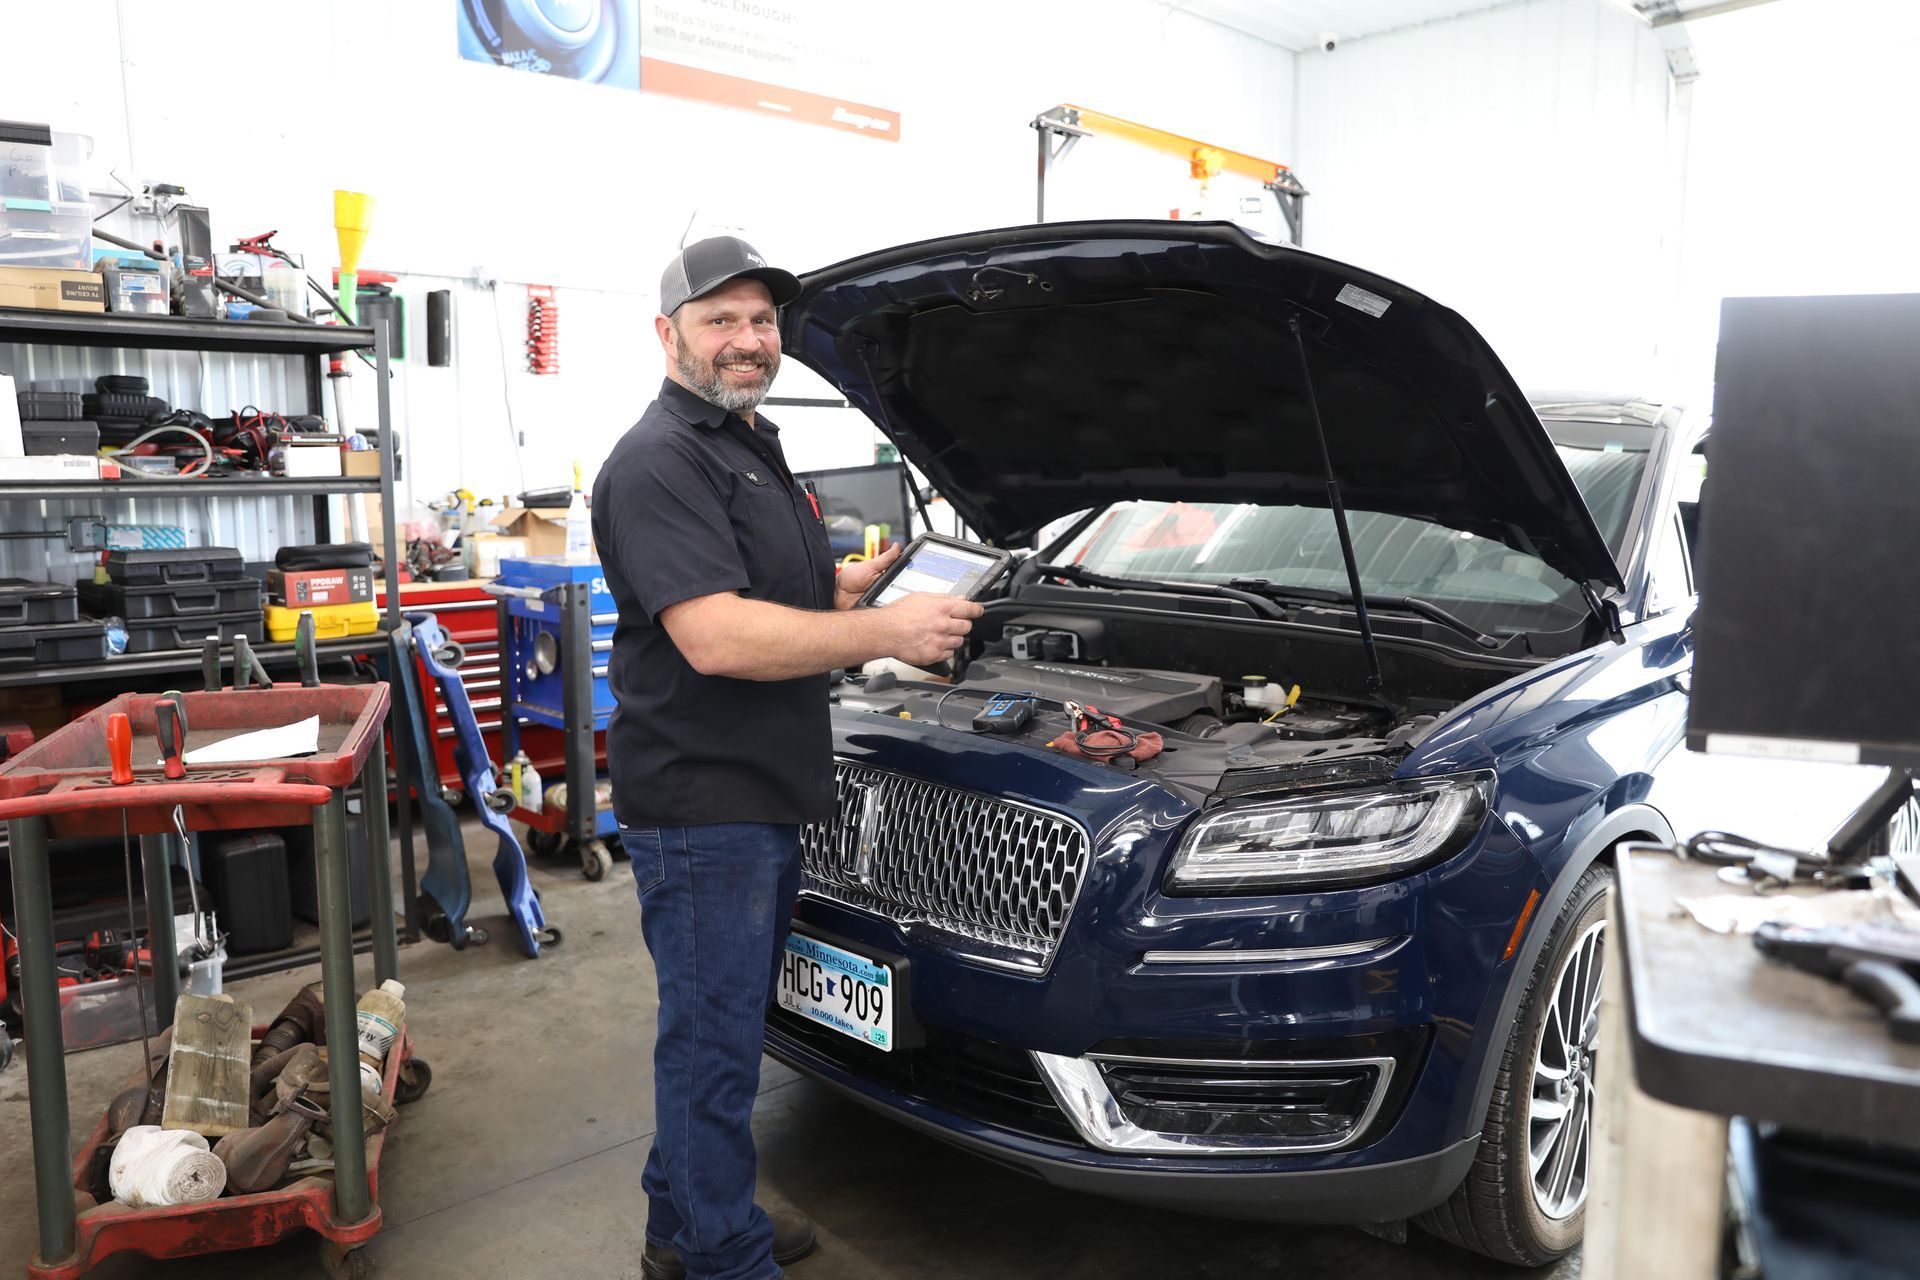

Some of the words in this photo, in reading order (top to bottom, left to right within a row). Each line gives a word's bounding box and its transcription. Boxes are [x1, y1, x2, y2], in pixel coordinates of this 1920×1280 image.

[653, 25, 677, 39] with
[679, 31, 696, 44] our
[698, 36, 745, 54] advanced
[66, 290, 90, 298] CEILING
[78, 284, 99, 292] MOUNT
[91, 291, 99, 299] TV
[783, 951, 823, 1003] HCG
[841, 974, 884, 1026] 909
[811, 1007, 834, 1023] 10,000
[835, 1016, 855, 1031] lakes
